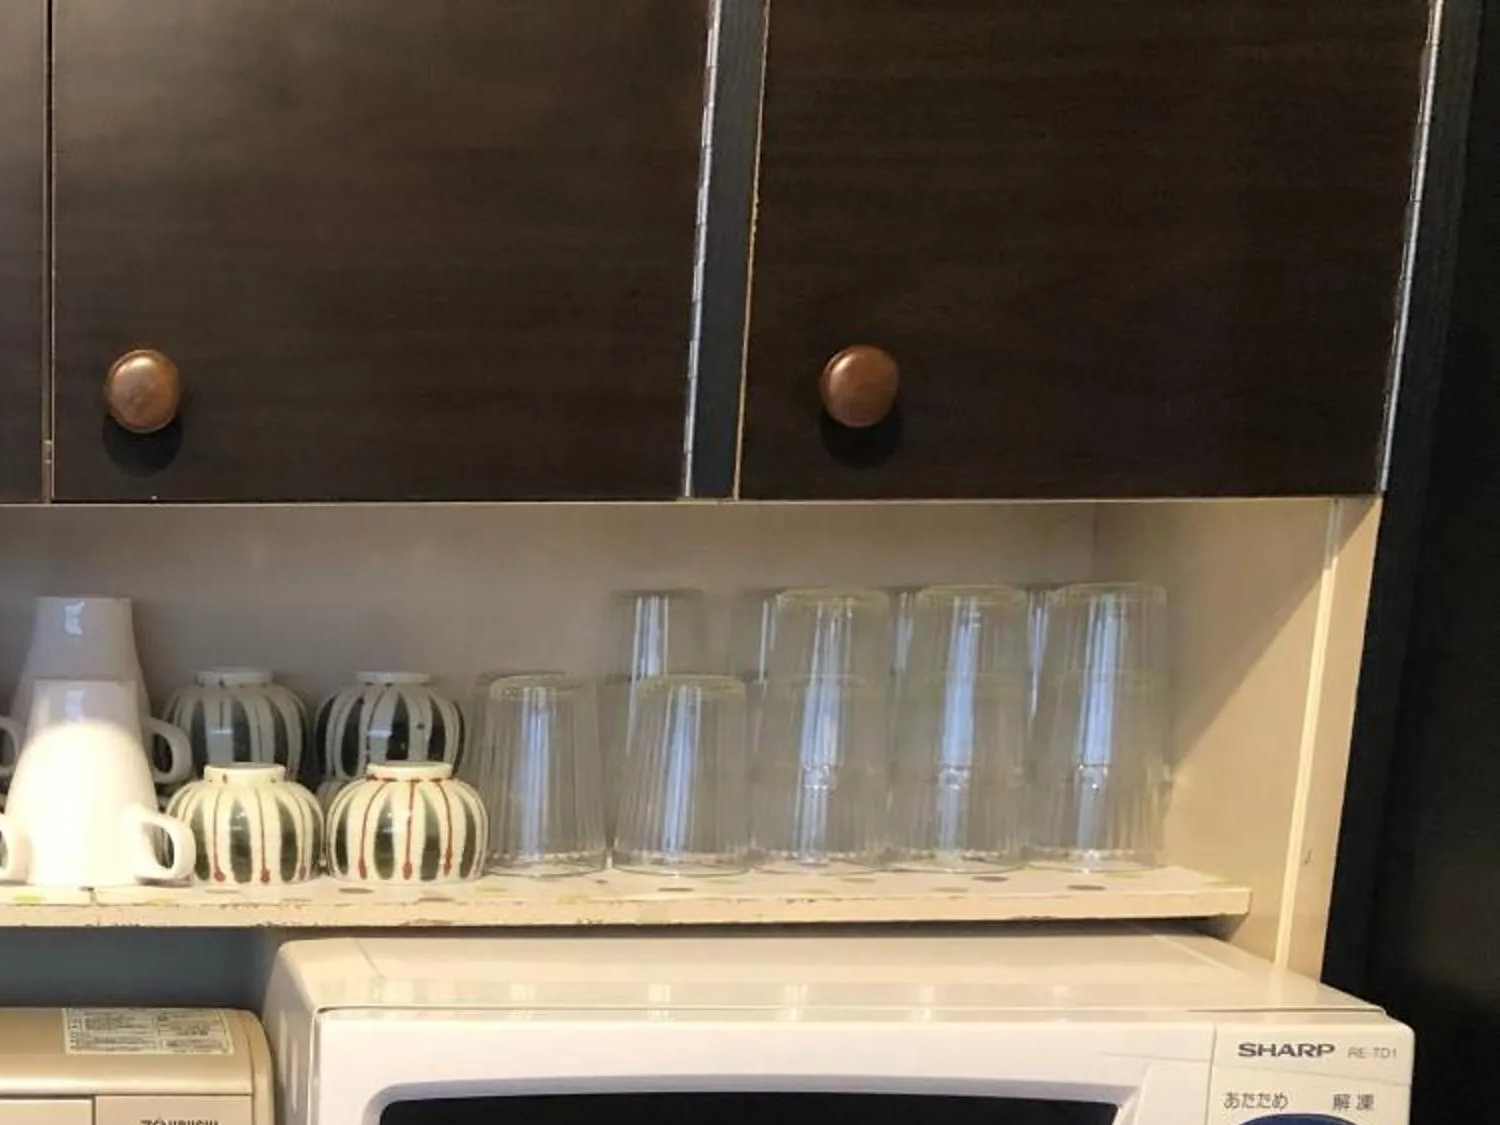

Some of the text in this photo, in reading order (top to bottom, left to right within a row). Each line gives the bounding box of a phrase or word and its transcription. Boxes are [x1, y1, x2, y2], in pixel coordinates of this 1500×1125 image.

[1237, 1042, 1336, 1058] SHARP
[1223, 1092, 1289, 1110] あたため
